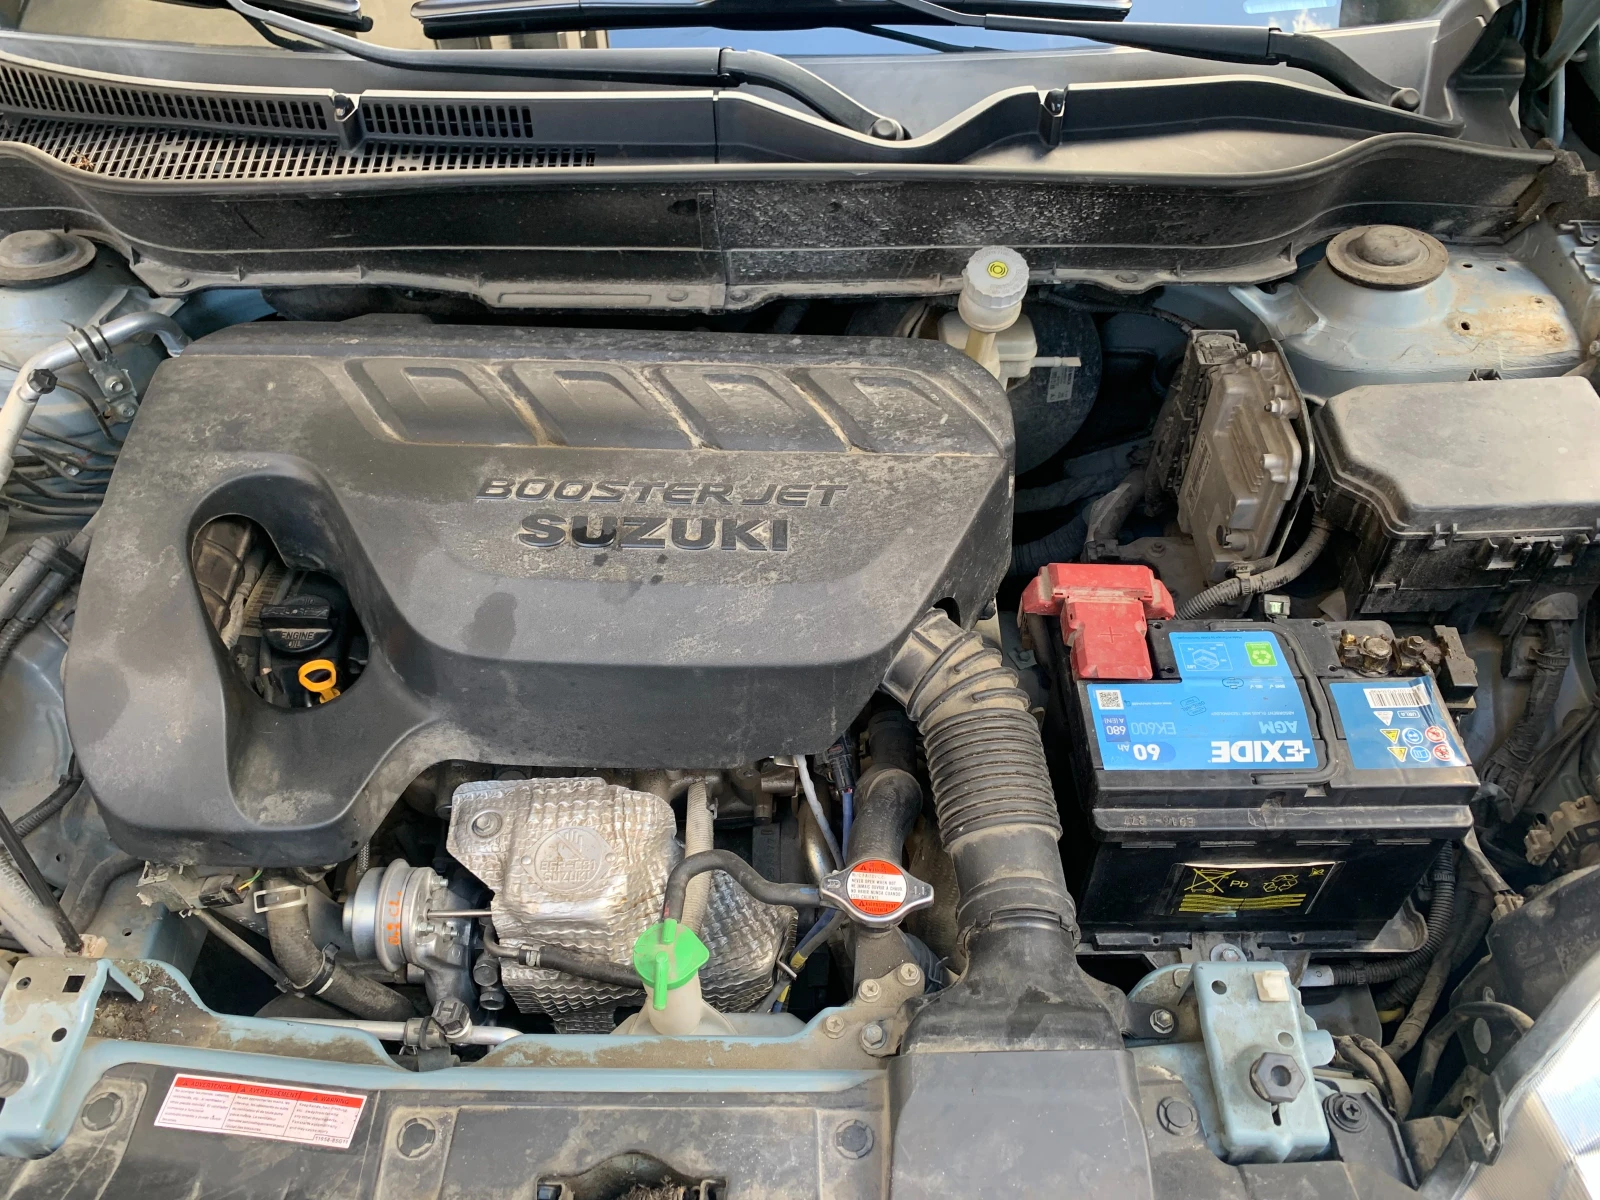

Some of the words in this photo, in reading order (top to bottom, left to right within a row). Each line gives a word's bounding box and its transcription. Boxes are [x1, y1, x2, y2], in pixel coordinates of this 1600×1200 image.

[518, 513, 789, 552] SUZUKI
[281, 631, 315, 640] ENGINE
[287, 640, 302, 648] OIL
[1106, 725, 1127, 735] 680
[1130, 721, 1177, 735] EK600
[1259, 720, 1298, 734] AGM
[1117, 744, 1130, 752] Ah
[1132, 743, 1161, 761] 60
[1211, 740, 1310, 763] EXIDE
[543, 871, 591, 883] SUZUKI
[1229, 879, 1249, 889] Pb
[190, 1081, 232, 1091] ADVERTENCIA
[248, 1087, 299, 1098] AVERTISSEMENT
[320, 1096, 349, 1105] WARNING
